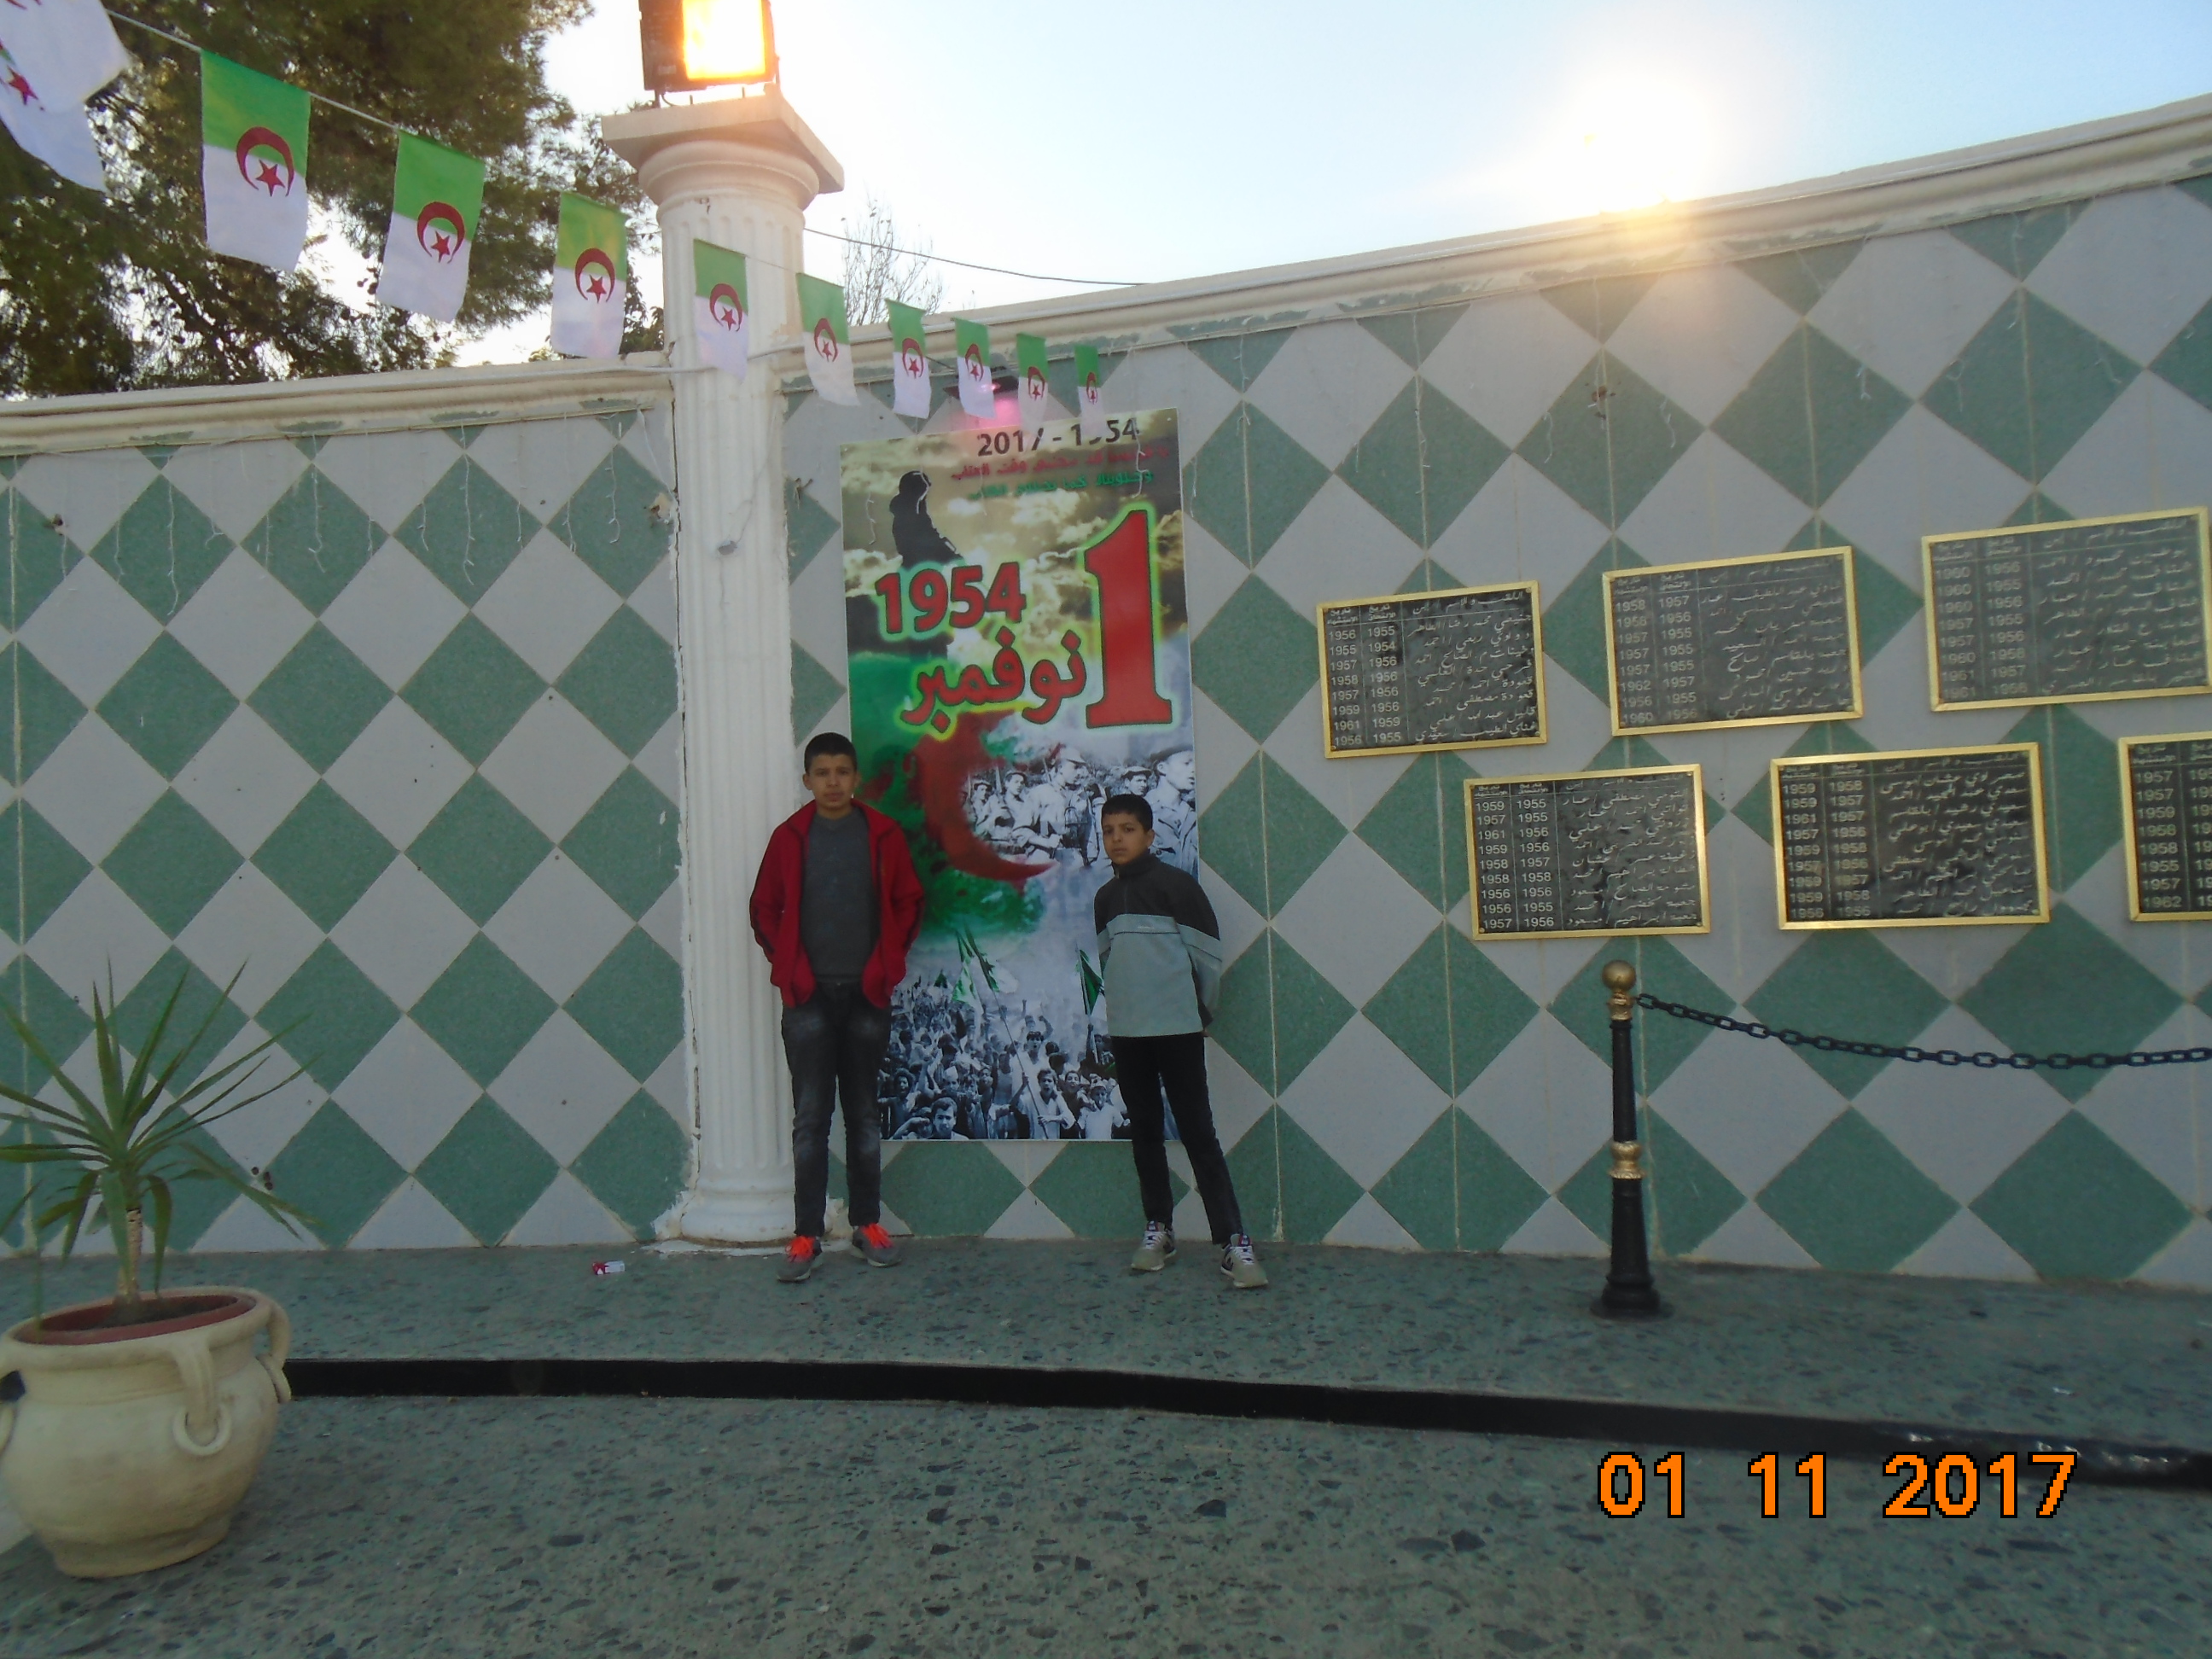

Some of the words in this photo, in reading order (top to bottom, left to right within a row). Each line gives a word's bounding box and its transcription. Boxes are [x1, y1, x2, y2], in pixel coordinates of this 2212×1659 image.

[1071, 417, 1139, 446] 154
[875, 561, 1027, 634] 1954
[1084, 509, 1173, 729] 1
[1329, 630, 1356, 641] 1956
[1368, 626, 1395, 637] 1955
[1330, 644, 1357, 656] 1955
[1368, 641, 1396, 653] 1954
[1619, 648, 1649, 660] 1957
[1330, 660, 1358, 671] 1957
[1369, 655, 1397, 667] 1956
[899, 626, 1086, 733] نوفمبر
[1331, 674, 1359, 686] 1958
[1370, 671, 1398, 683] 1956
[1332, 690, 1359, 701] 1957
[1371, 686, 1399, 698] 1956
[1333, 704, 1360, 716] 1959
[1371, 701, 1400, 713] 1956
[1334, 719, 1361, 731] 1961
[1372, 716, 1400, 728] 1959
[1335, 735, 1362, 746] 1956
[1373, 731, 1401, 743] 1955
[1476, 801, 1505, 812] 1959
[1516, 799, 1546, 809] 1955
[1476, 816, 1506, 827] 1957
[1517, 813, 1547, 824] 1955
[1477, 830, 1507, 841] 1961
[1518, 828, 1548, 839] 1956
[1478, 845, 1508, 856] 1959
[1519, 843, 1550, 853] 1956
[1479, 859, 1509, 870] 1958
[1520, 858, 1551, 869] 1957
[1480, 874, 1510, 885] 1958
[1521, 872, 1551, 883] 1958
[1481, 888, 1511, 900] 1956
[1522, 888, 1552, 898] 1956
[1481, 903, 1511, 915] 1956
[1523, 902, 1553, 913] 1955
[1483, 918, 1512, 929] 1957
[1524, 917, 1554, 928] 1956
